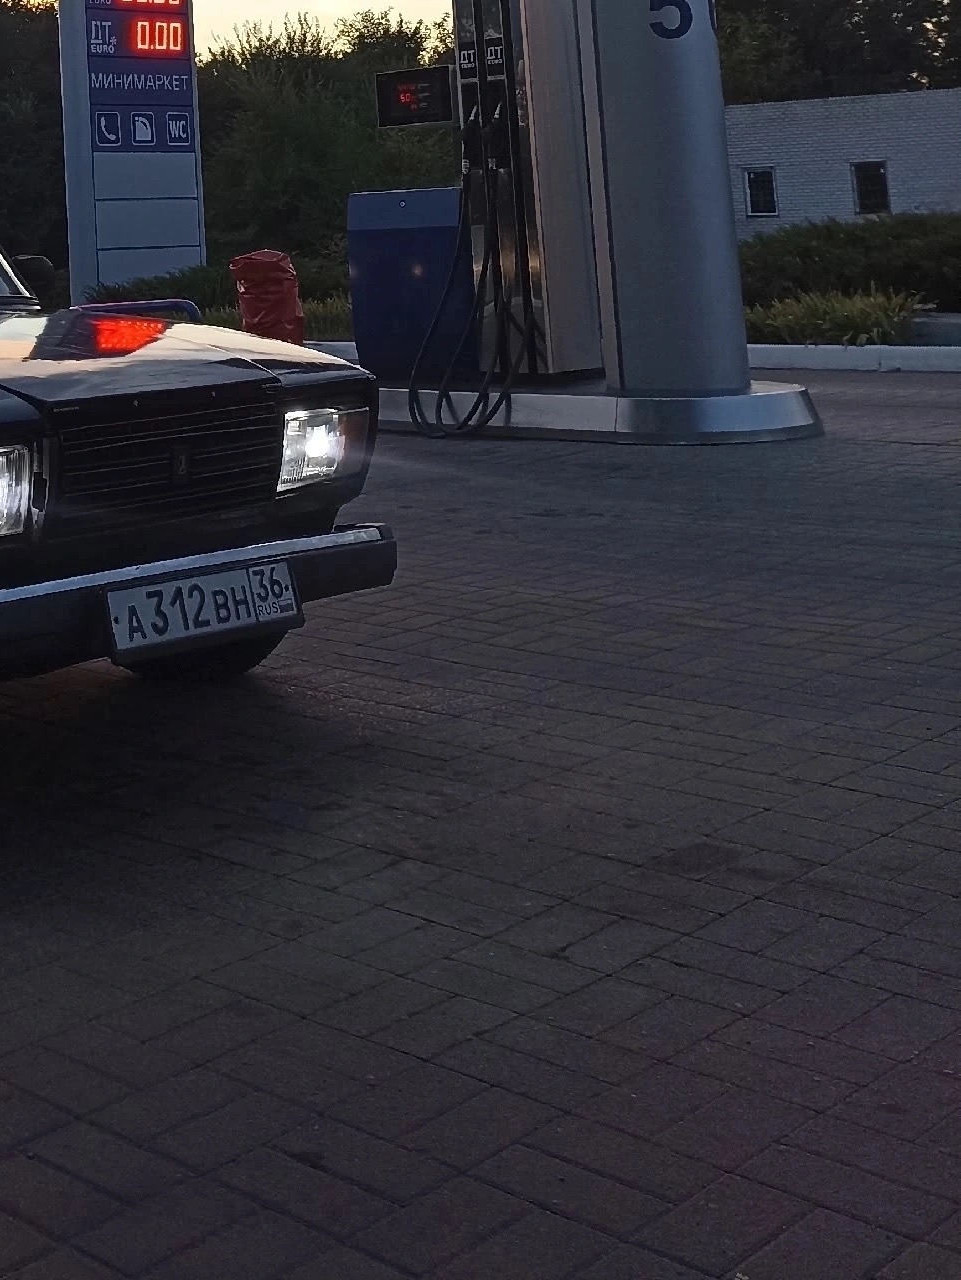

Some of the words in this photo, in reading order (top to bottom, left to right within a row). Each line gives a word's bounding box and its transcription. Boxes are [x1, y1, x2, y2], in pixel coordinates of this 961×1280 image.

[137, 21, 182, 51] 0.00
[91, 44, 115, 54] EURO
[460, 49, 475, 64] ДТ
[486, 46, 503, 60] ДТ
[91, 72, 189, 91] МИНИМАРКЕТ
[168, 120, 187, 139] WC
[127, 582, 252, 642] А312ВН
[251, 567, 284, 603] 36
[257, 603, 279, 616] RUS
